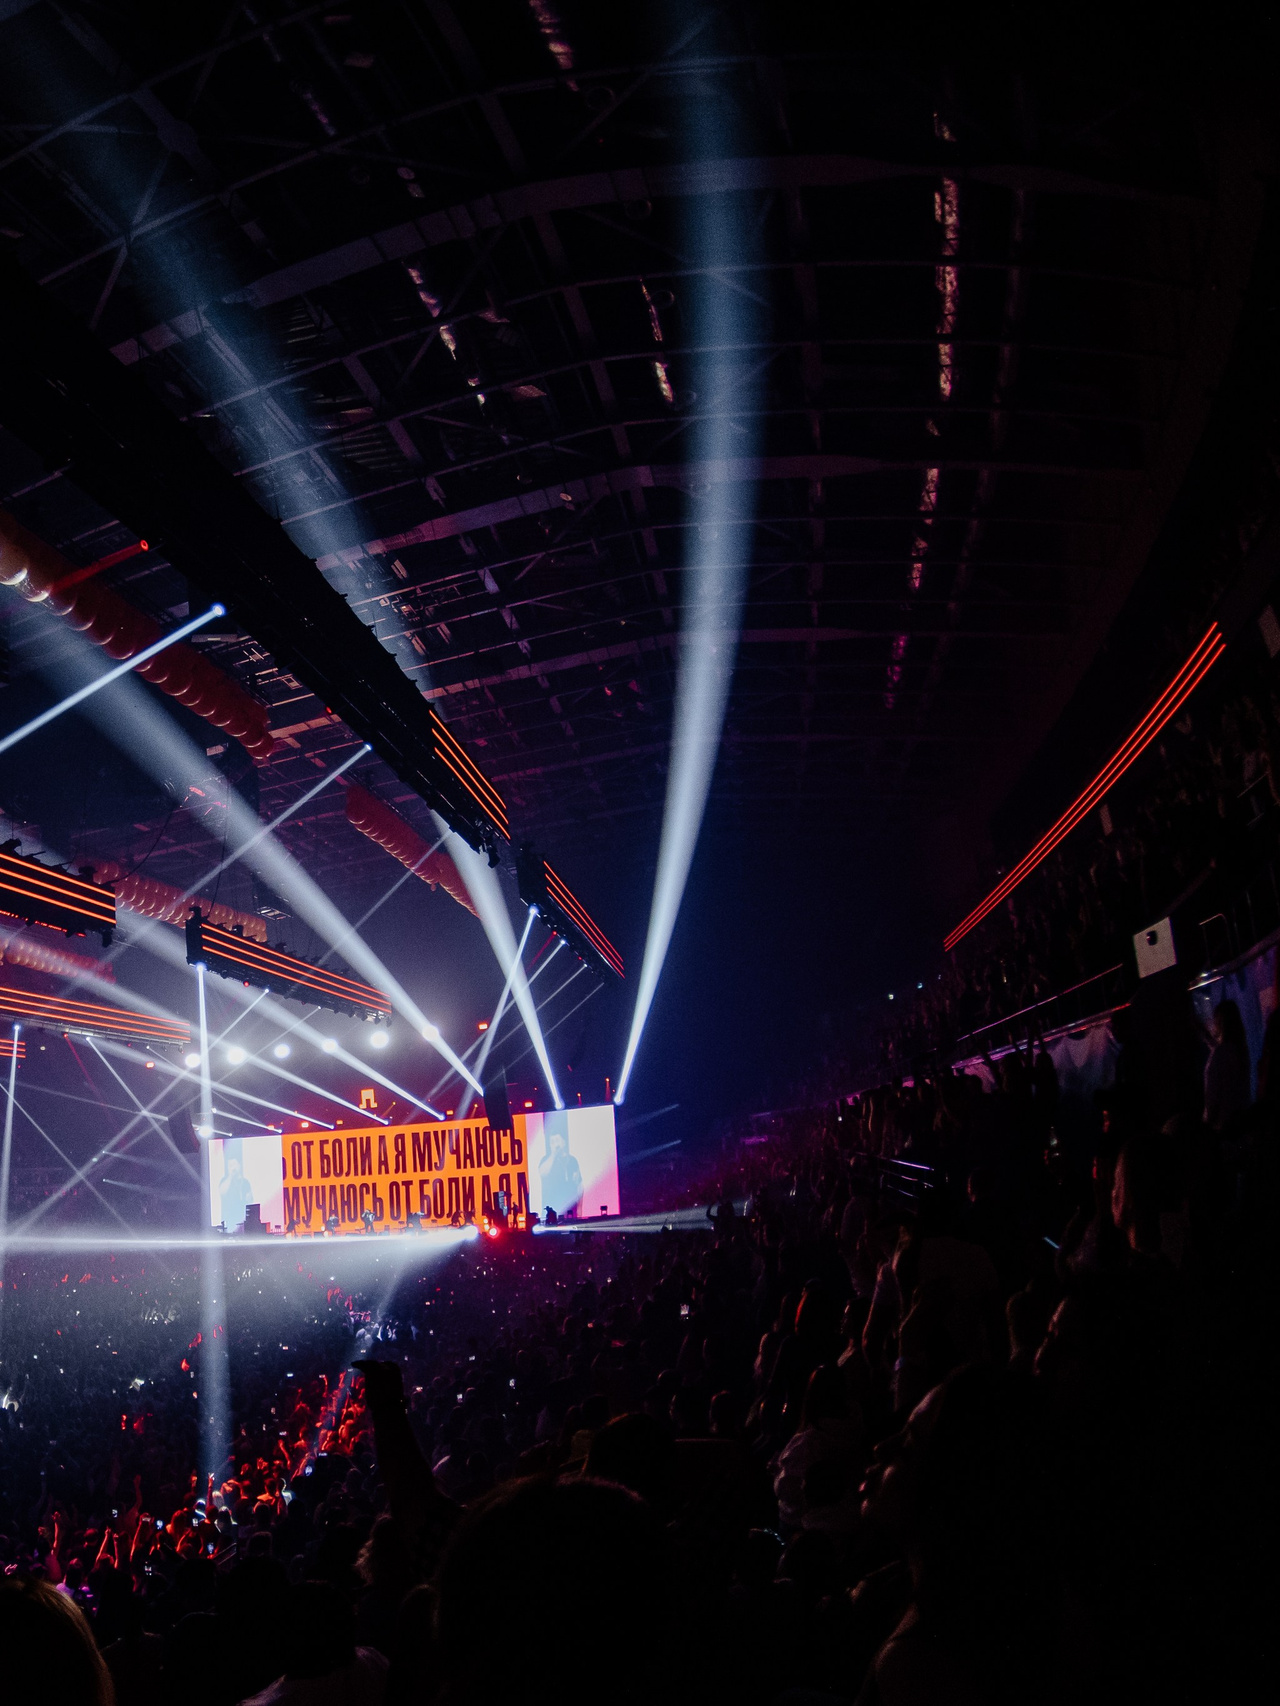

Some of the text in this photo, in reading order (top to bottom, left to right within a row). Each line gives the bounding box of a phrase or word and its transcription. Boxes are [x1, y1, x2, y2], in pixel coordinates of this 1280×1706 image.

[291, 1140, 314, 1180] ОТ
[319, 1136, 372, 1178] БОЛИ
[378, 1135, 389, 1175] А
[394, 1133, 407, 1174] Я
[411, 1124, 523, 1172] МУЧАЮСЬ
[283, 1182, 384, 1227] МУЧАЮСЬ
[389, 1180, 413, 1221] ОТ
[419, 1176, 475, 1219] БОЛИ
[481, 1175, 495, 1216] А
